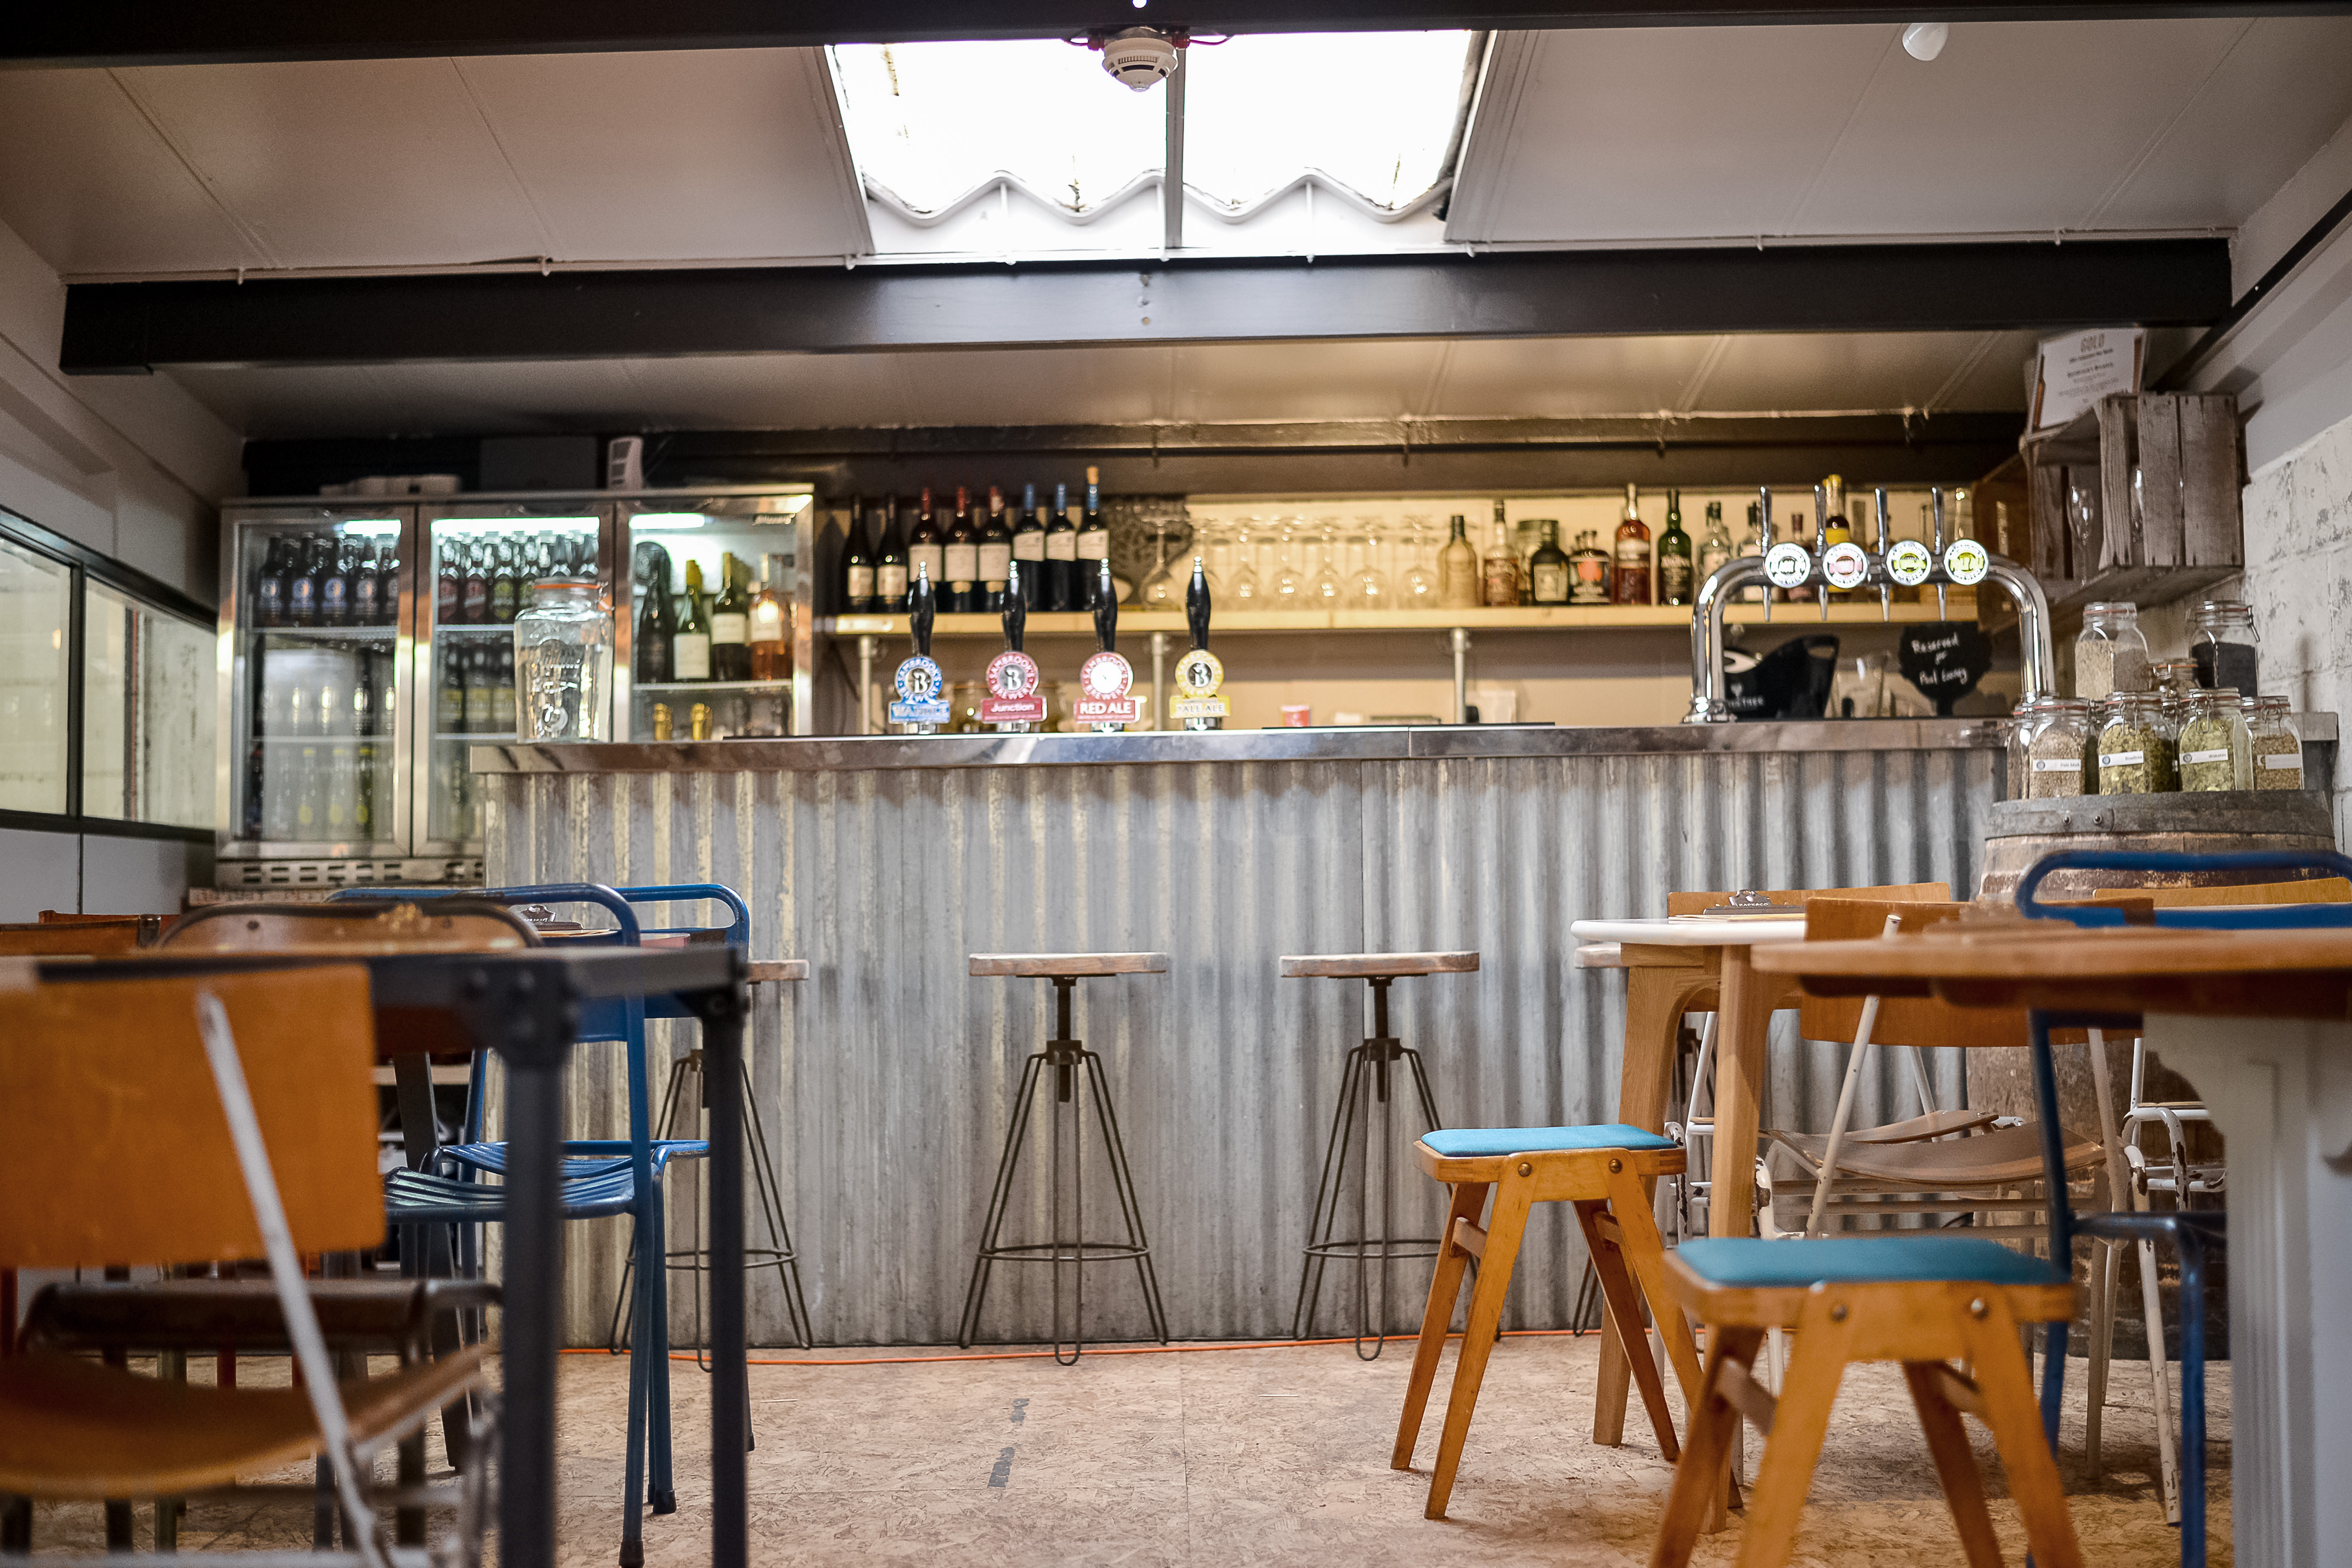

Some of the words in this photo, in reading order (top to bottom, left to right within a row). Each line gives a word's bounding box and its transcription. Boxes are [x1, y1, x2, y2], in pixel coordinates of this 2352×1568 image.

[1911, 631, 1959, 654] Reserved
[992, 683, 1031, 700] BREWERY
[1086, 684, 1124, 700] BREWERY
[991, 702, 1034, 712] Junction
[1079, 703, 1107, 714] RED
[1107, 702, 1132, 714] ALE
[1205, 704, 1224, 712] ALE
